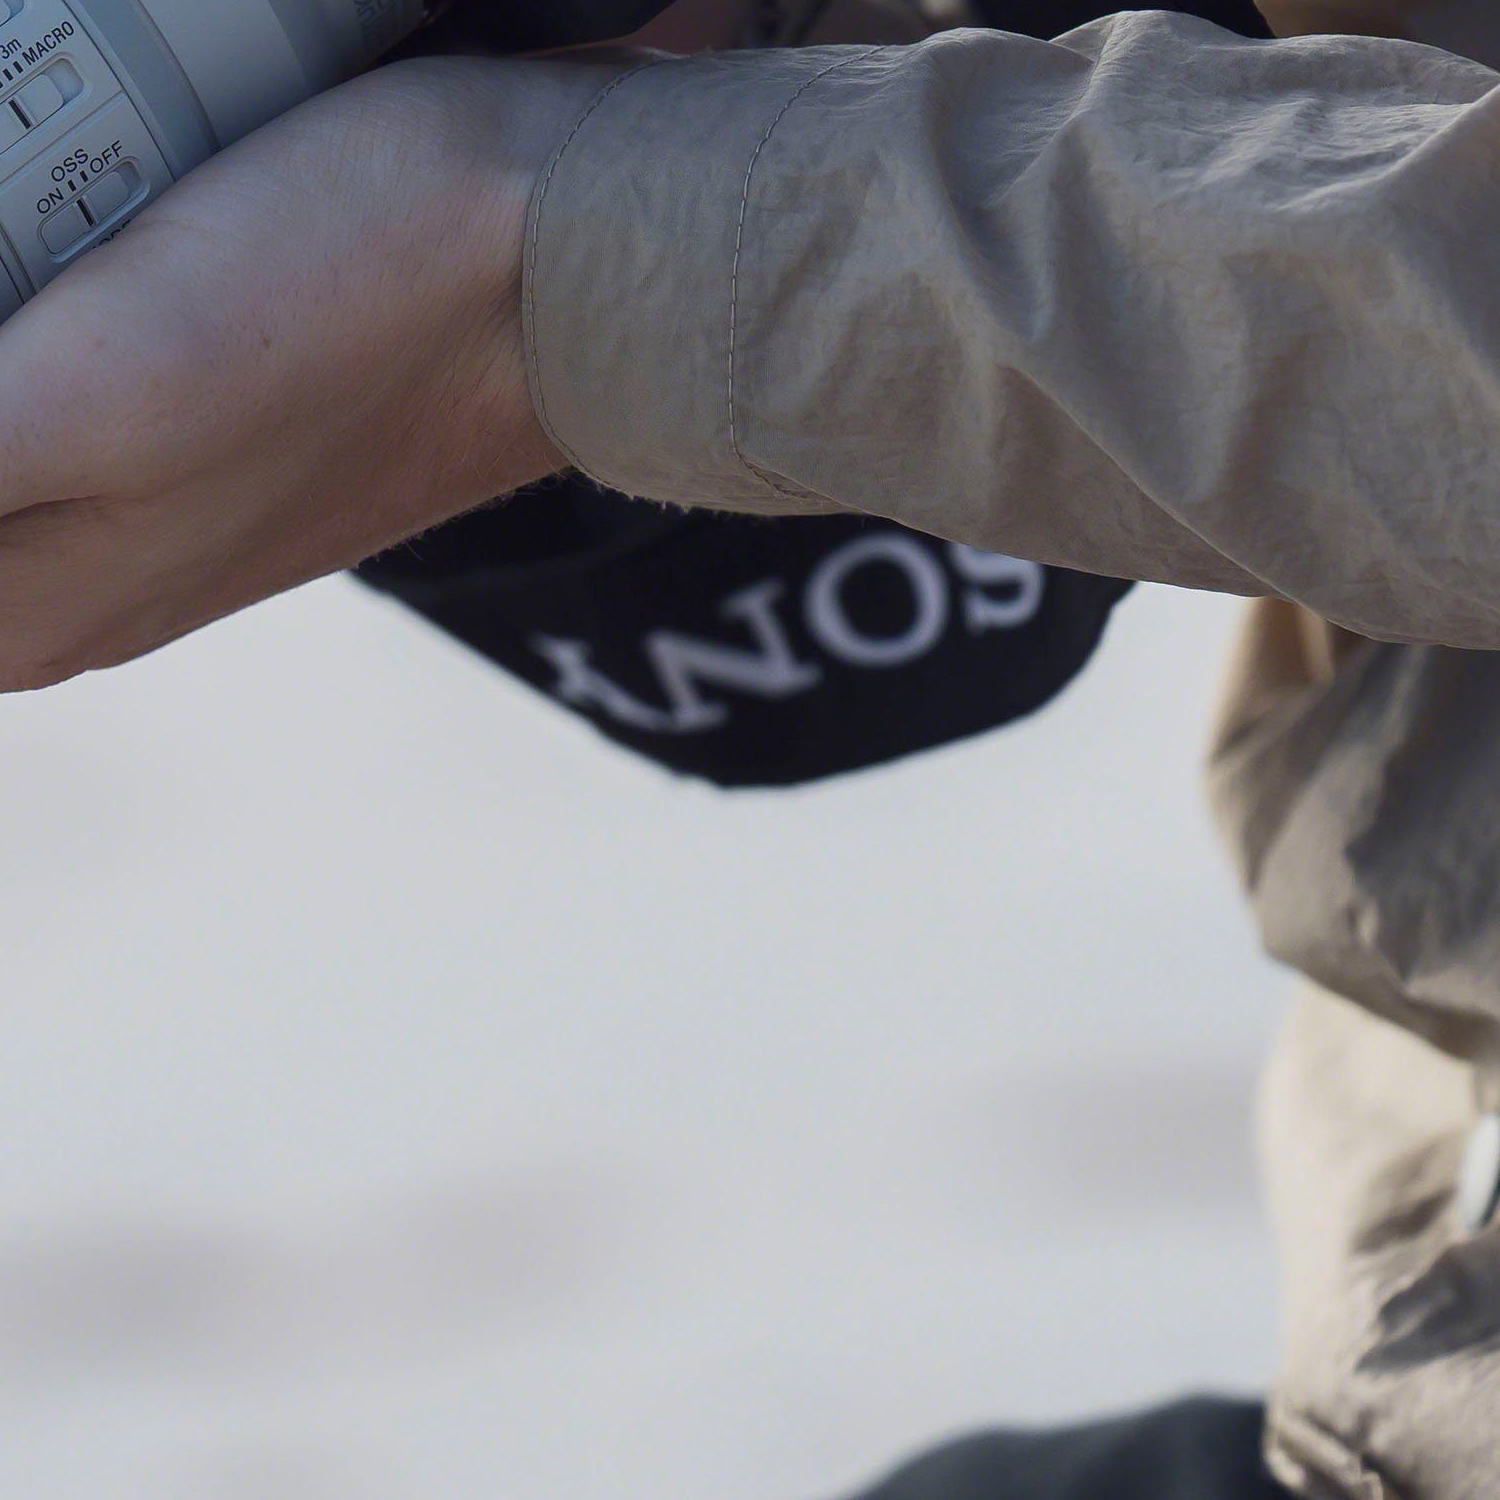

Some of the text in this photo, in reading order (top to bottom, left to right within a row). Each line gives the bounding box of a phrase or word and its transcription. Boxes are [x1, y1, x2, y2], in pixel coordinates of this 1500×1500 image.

[23, 20, 75, 66] MACRO
[37, 140, 123, 215] ON OFF
[51, 148, 89, 182] OSS
